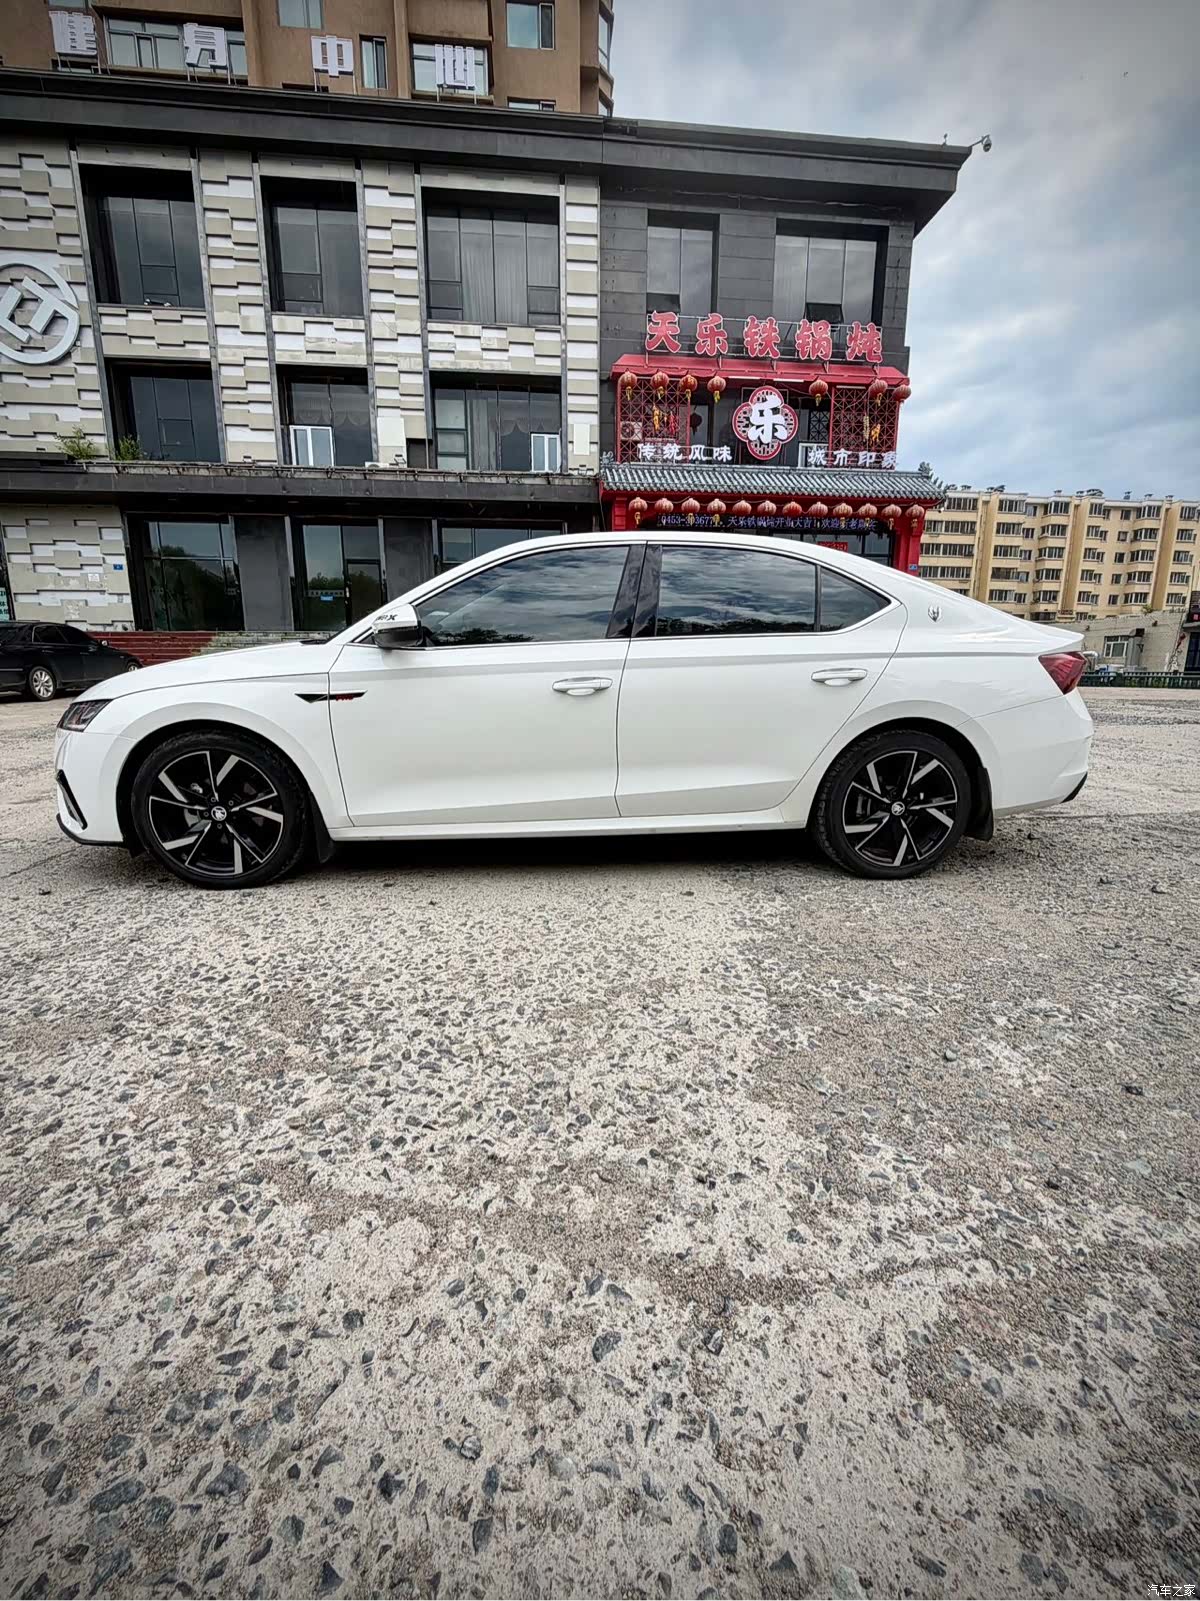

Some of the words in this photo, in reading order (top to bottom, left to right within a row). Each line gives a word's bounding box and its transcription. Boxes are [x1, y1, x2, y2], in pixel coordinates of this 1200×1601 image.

[645, 310, 883, 363] 天乐铁锅炖
[748, 394, 787, 444] 乐
[637, 442, 732, 462] 传统风味
[807, 445, 897, 469] 城市印象
